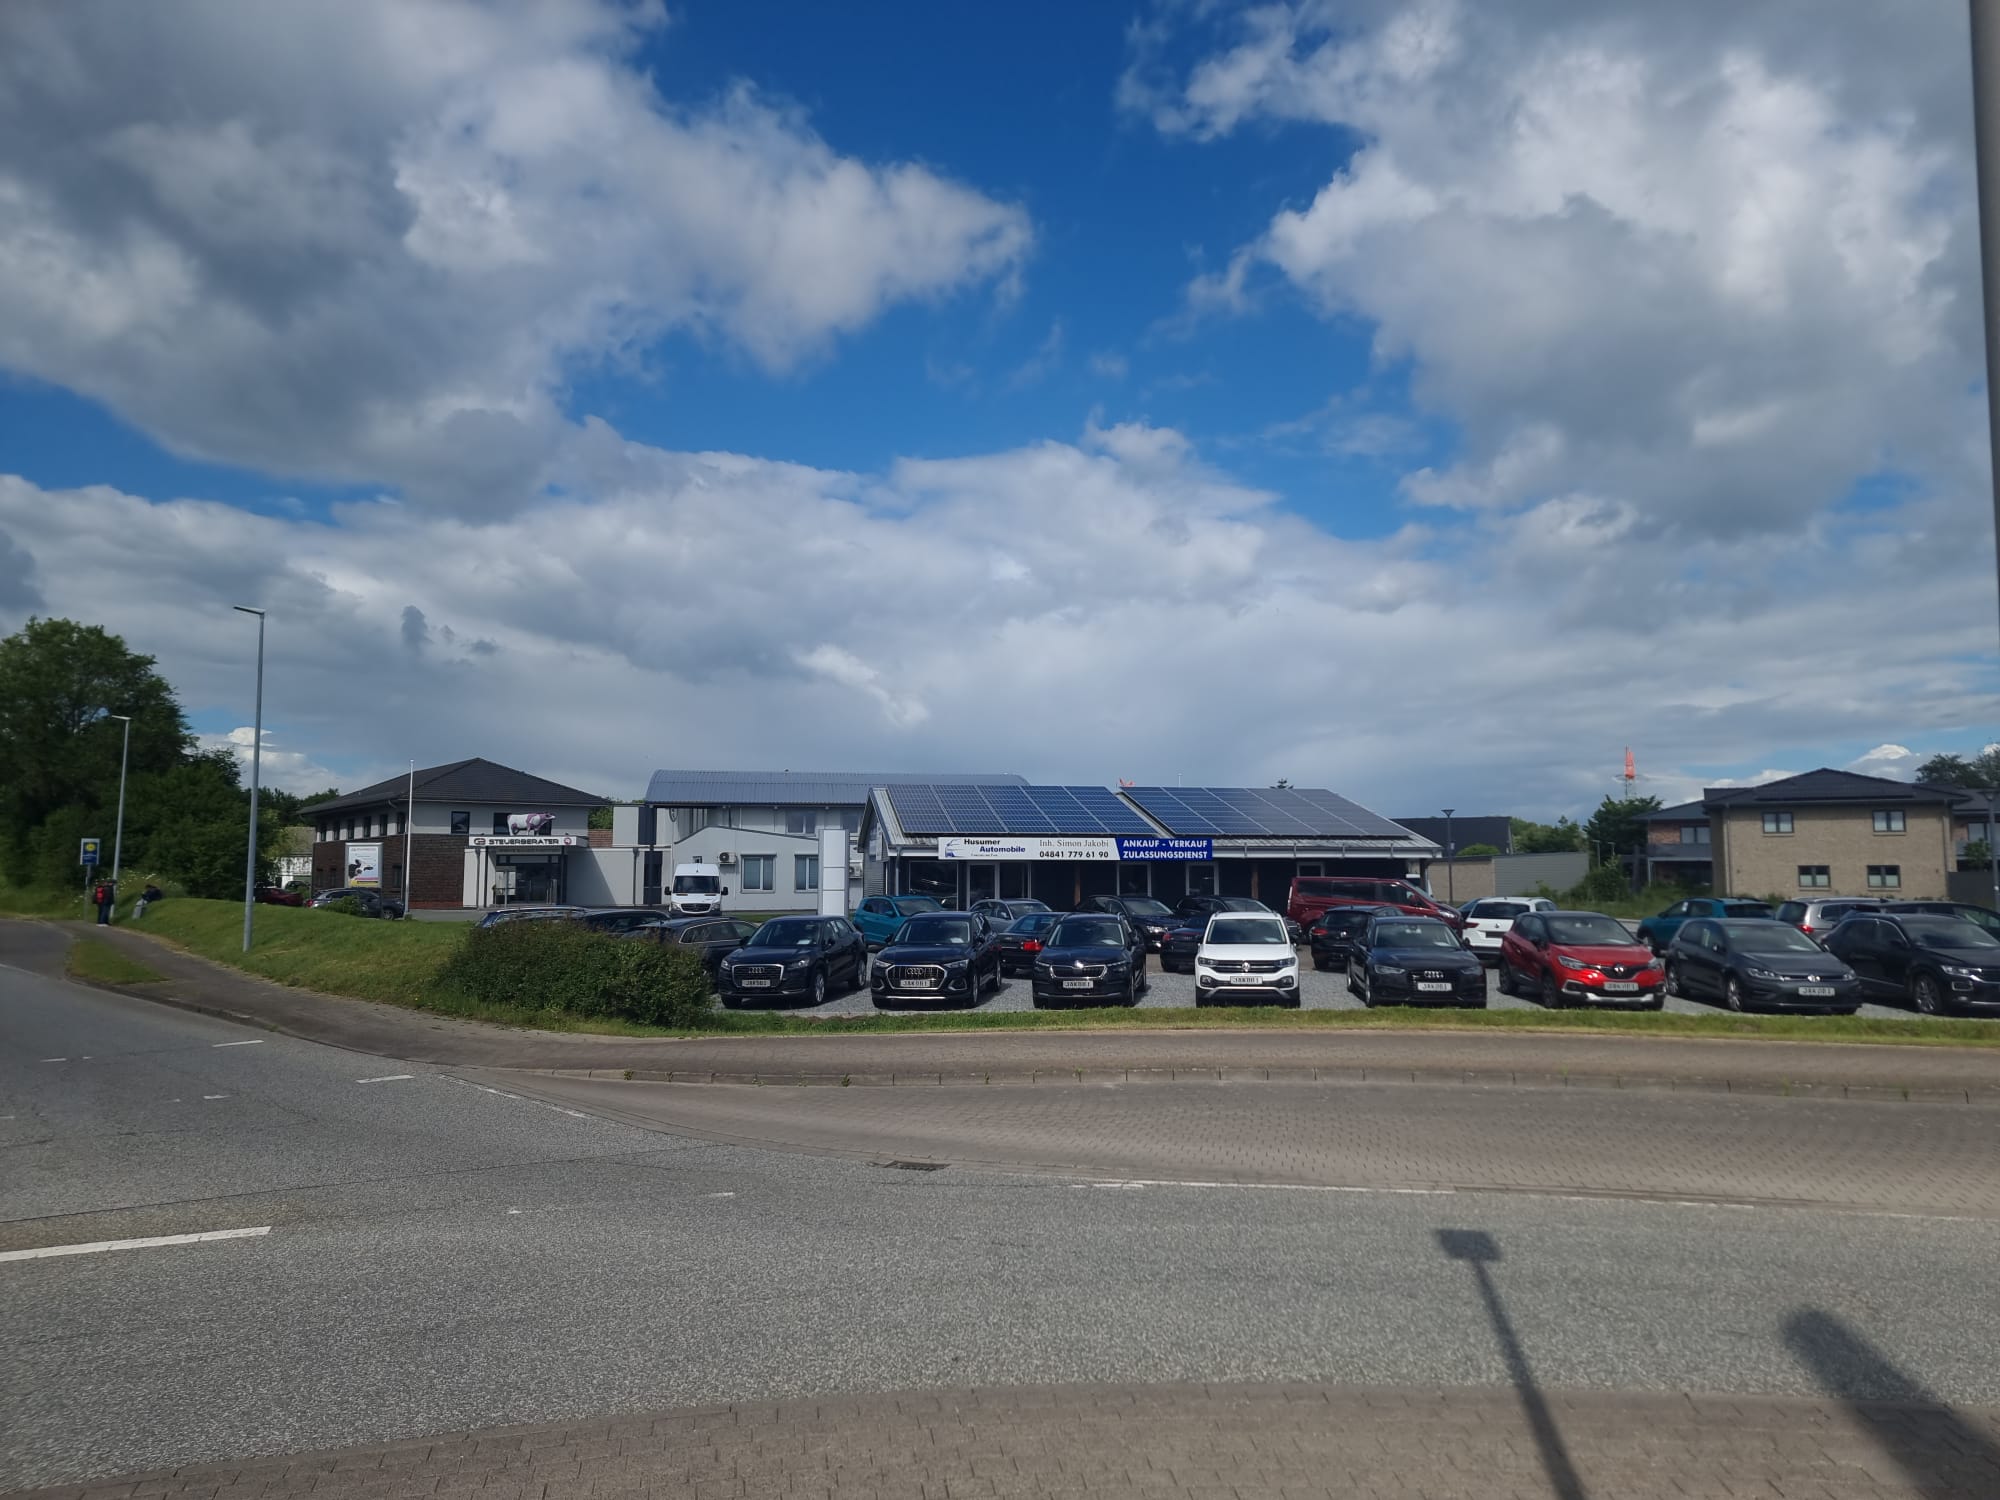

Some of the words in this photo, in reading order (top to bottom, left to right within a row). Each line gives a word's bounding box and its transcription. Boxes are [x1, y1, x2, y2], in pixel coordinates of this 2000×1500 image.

[1040, 839, 1054, 847] Inh.
[1057, 839, 1081, 847] Simon
[1084, 839, 1109, 847] Jakobi
[1123, 839, 1159, 847] ANKAUF
[1168, 839, 1208, 847] VERKAUF
[979, 845, 1026, 853] Automobile
[1039, 850, 1064, 858] 04841
[1068, 850, 1083, 858] 779
[1086, 850, 1095, 858] 61
[1098, 850, 1109, 858] 90
[1122, 850, 1208, 858] ZULASSUNGSDIENST
